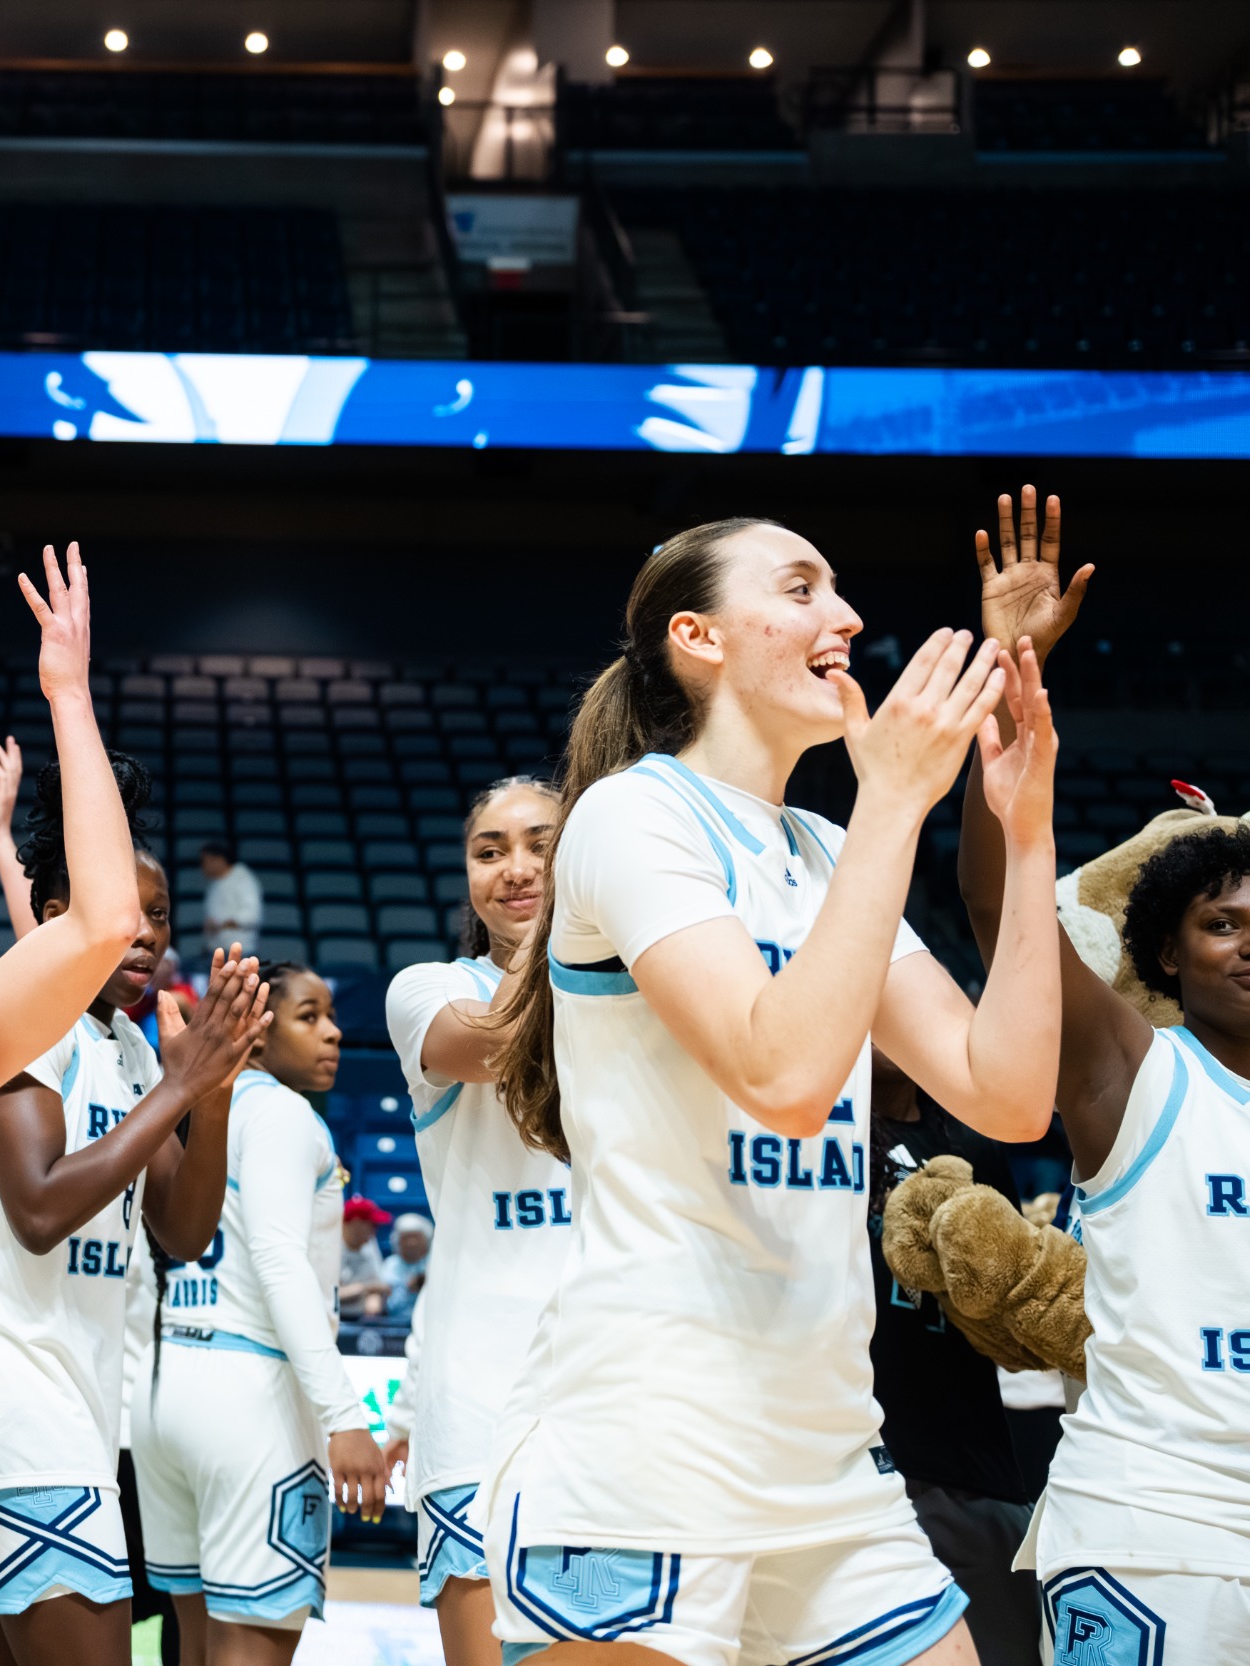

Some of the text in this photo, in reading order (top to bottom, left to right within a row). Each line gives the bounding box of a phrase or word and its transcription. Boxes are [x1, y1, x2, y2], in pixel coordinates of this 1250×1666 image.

[728, 1129, 865, 1194] ISLAD
[492, 1188, 572, 1230] ISL
[67, 1235, 133, 1279] ISL
